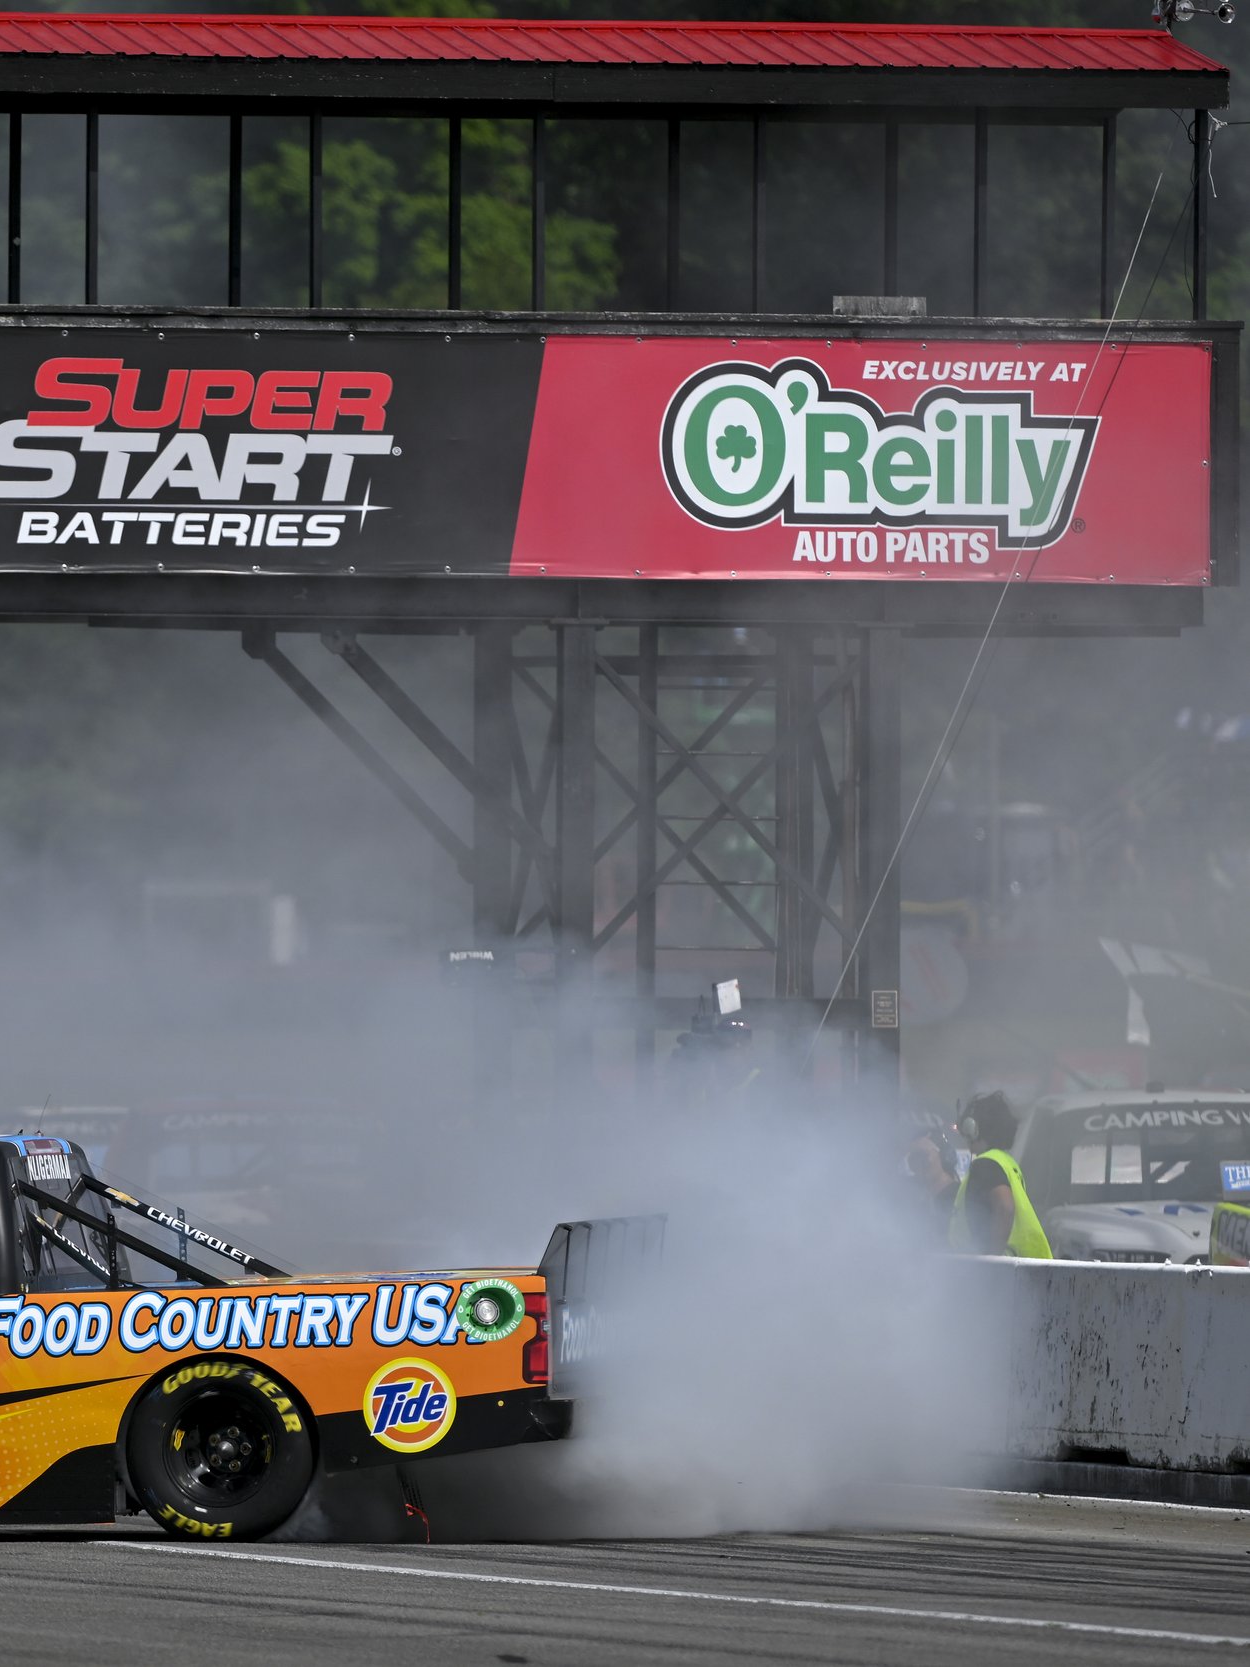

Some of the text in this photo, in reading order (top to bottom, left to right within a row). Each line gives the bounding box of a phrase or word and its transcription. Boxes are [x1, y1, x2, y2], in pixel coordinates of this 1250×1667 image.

[862, 360, 1087, 383] EXCLUSIVELY AT
[27, 357, 393, 432] SUPER
[676, 376, 1080, 533] O'Reilly
[16, 510, 347, 548] BATTERIES
[792, 531, 990, 564] AUTO PARTS
[1084, 1109, 1224, 1132] CAMPING
[27, 1154, 71, 1181] KLIGERMAN
[147, 1206, 255, 1265] CHEVROLET
[462, 1278, 519, 1299] GET BIOETHANOL
[462, 1319, 520, 1341] GET BIOETHANOL
[161, 1361, 303, 1433] GOODYEAR
[371, 1380, 448, 1436] Tide
[157, 1503, 233, 1538] EAGLE
